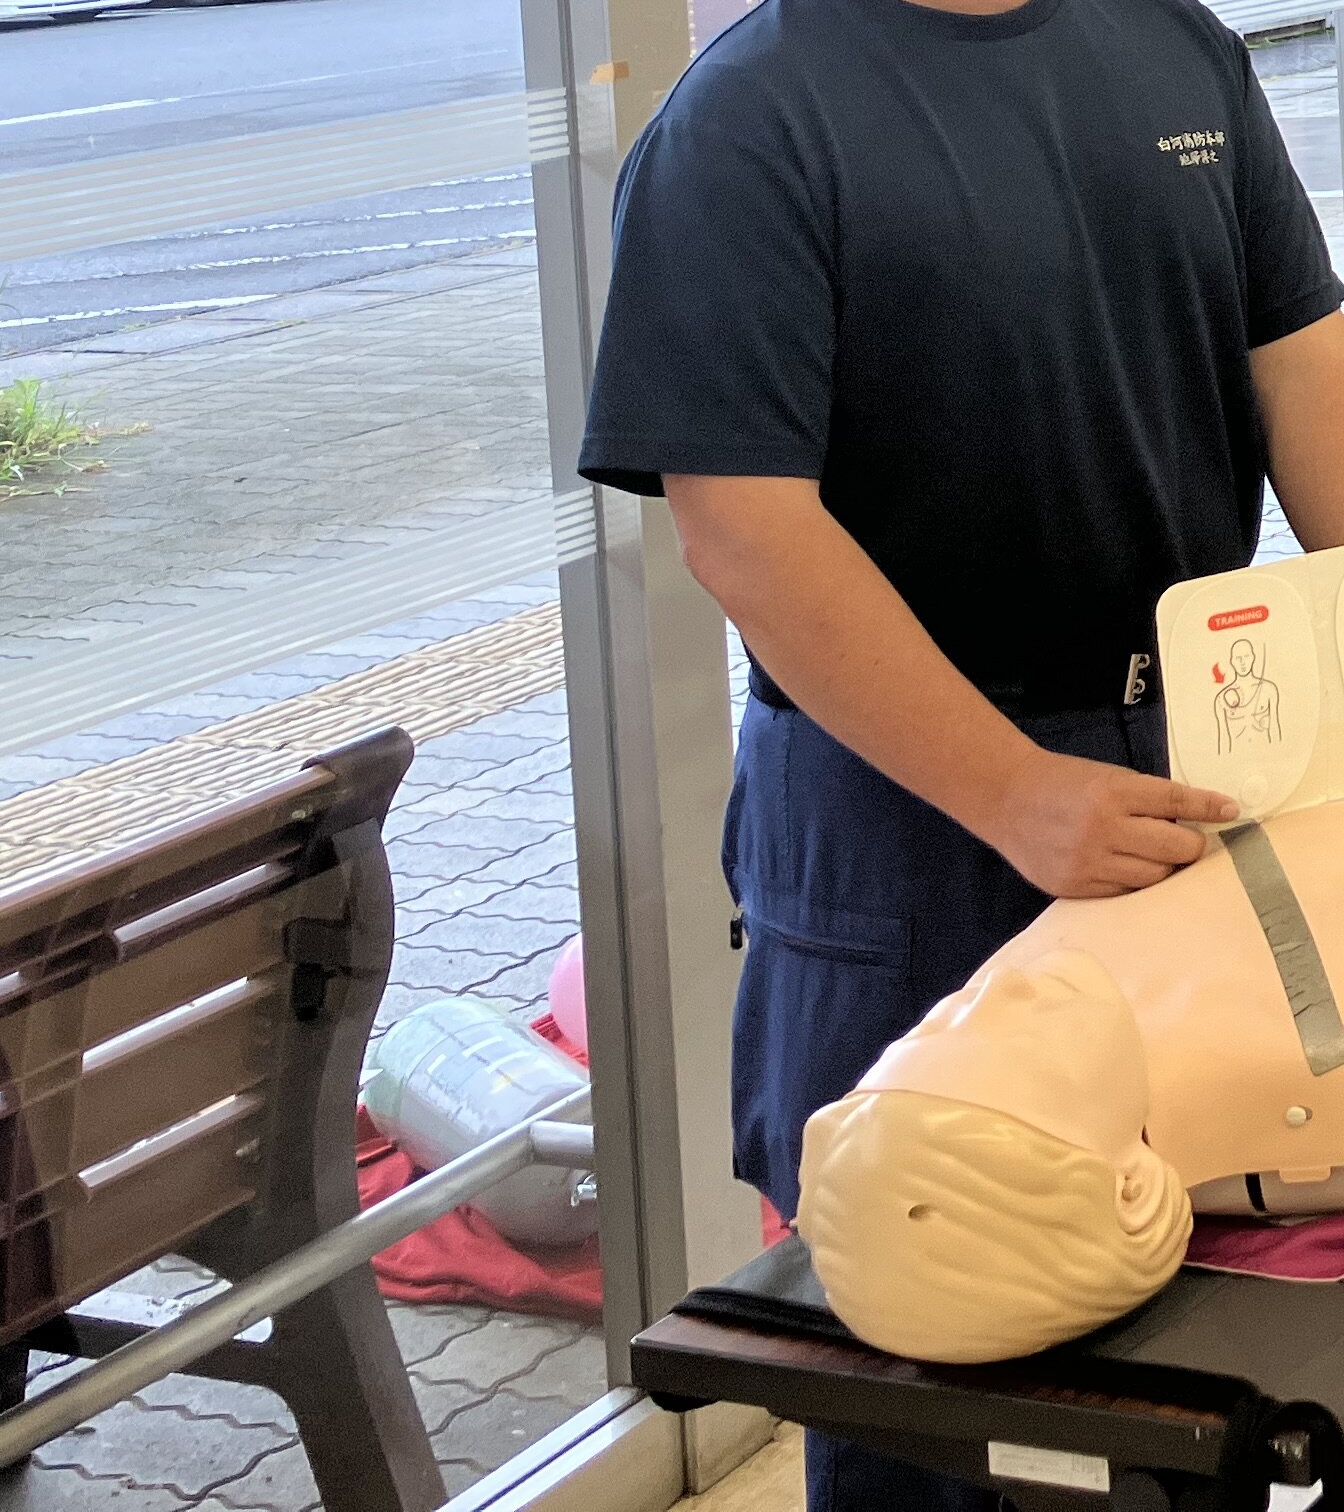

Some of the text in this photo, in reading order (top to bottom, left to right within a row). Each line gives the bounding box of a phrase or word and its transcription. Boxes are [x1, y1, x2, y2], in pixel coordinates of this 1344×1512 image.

[1157, 130, 1226, 152] 白河消防本部
[1215, 609, 1263, 627] TRAINING
